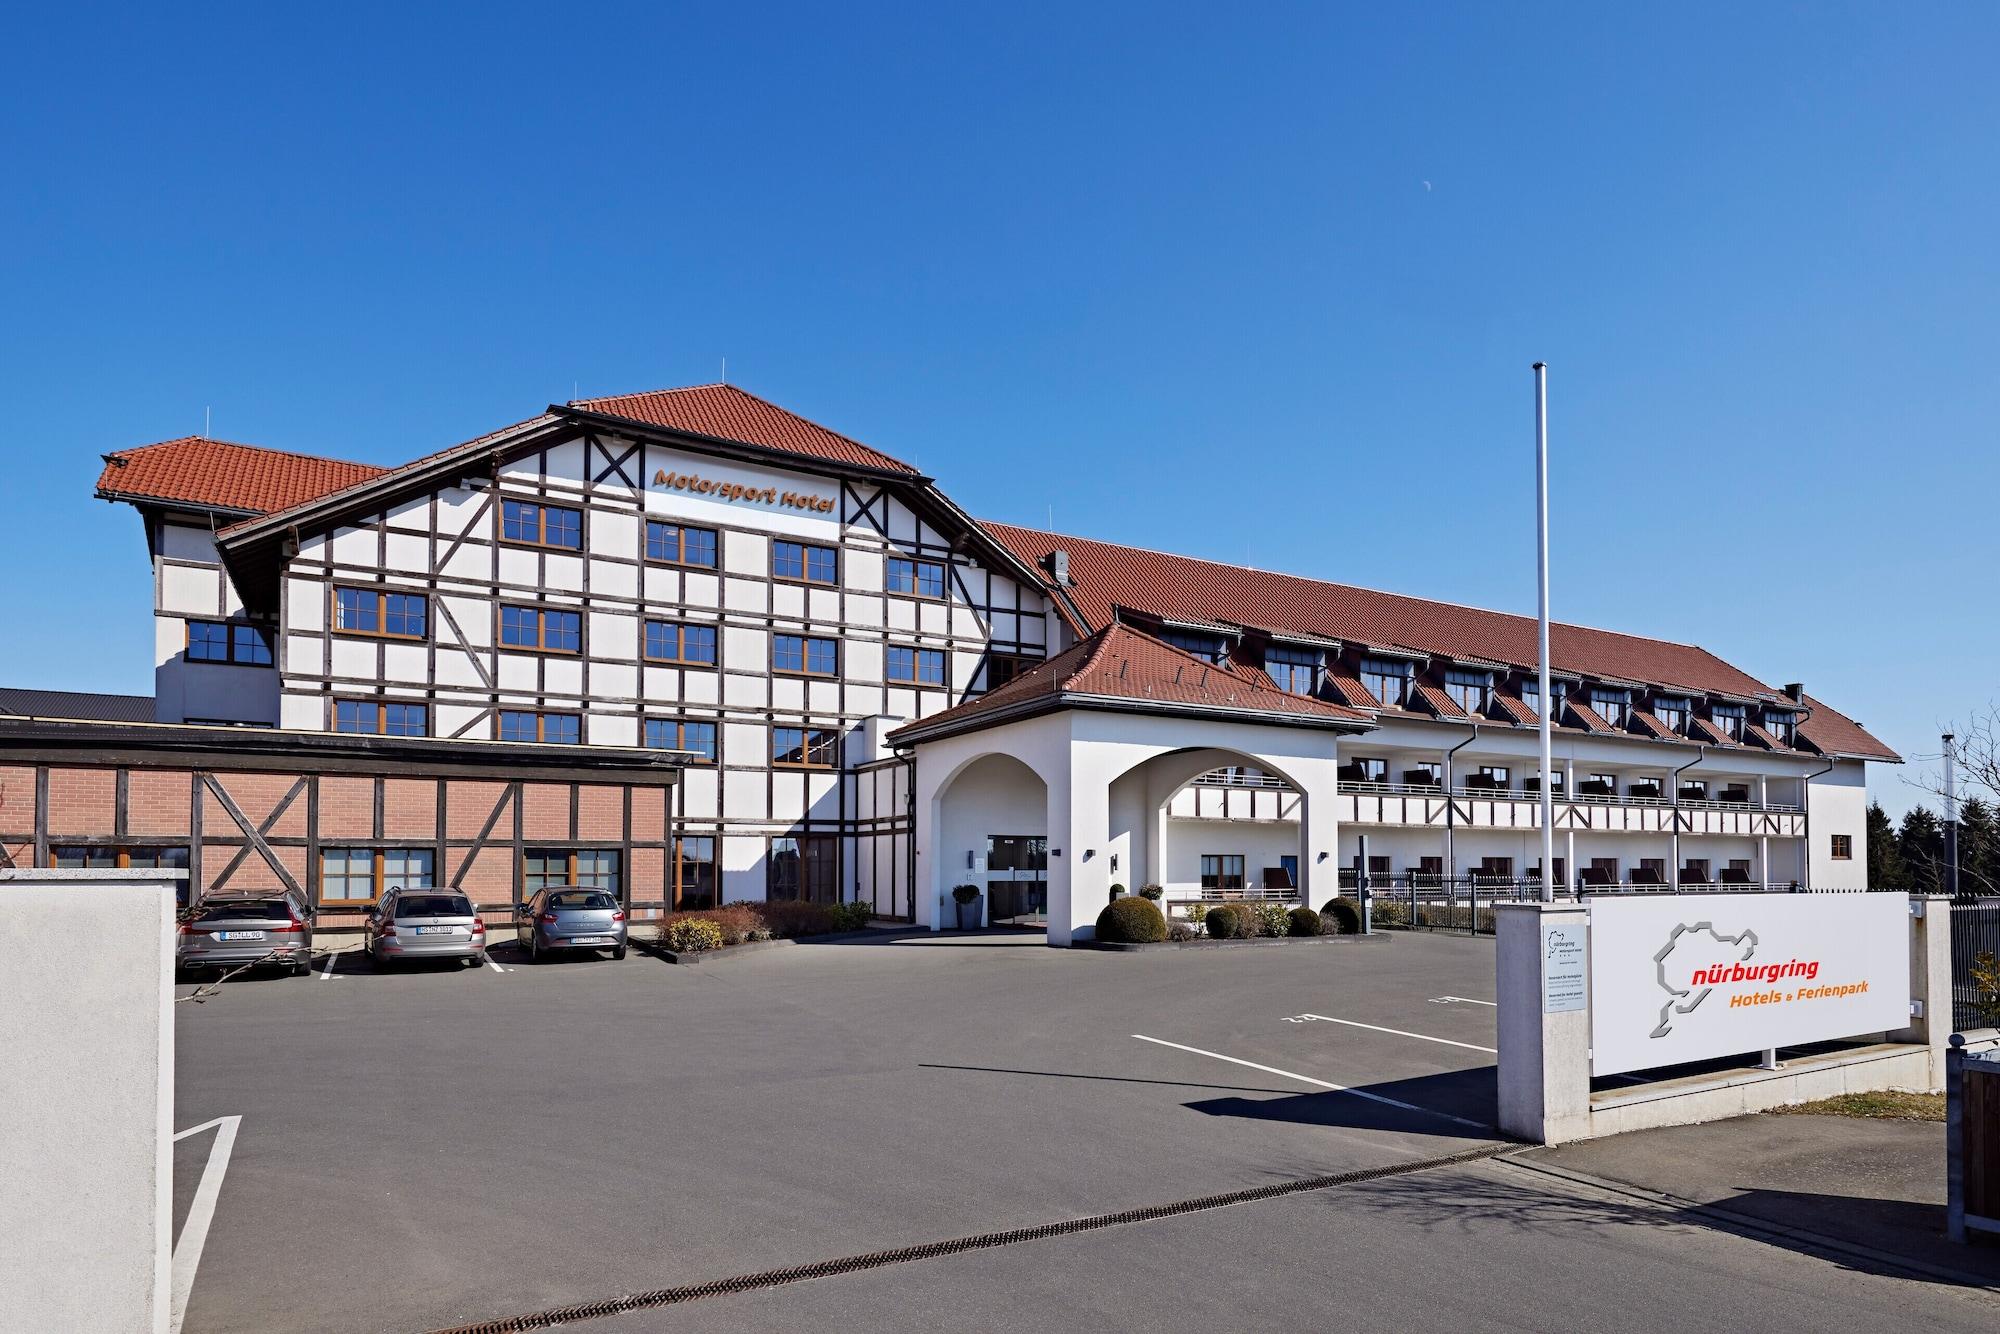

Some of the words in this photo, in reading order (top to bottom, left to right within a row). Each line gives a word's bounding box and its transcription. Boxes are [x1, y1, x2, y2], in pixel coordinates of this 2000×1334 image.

[653, 468, 777, 503] Motorsport
[779, 490, 836, 514] Hotel
[1691, 959, 1819, 986] nürburgring
[1729, 990, 1782, 1008] Hotels
[1786, 994, 1793, 1002] &
[1797, 980, 1869, 1001] Ferienpark
